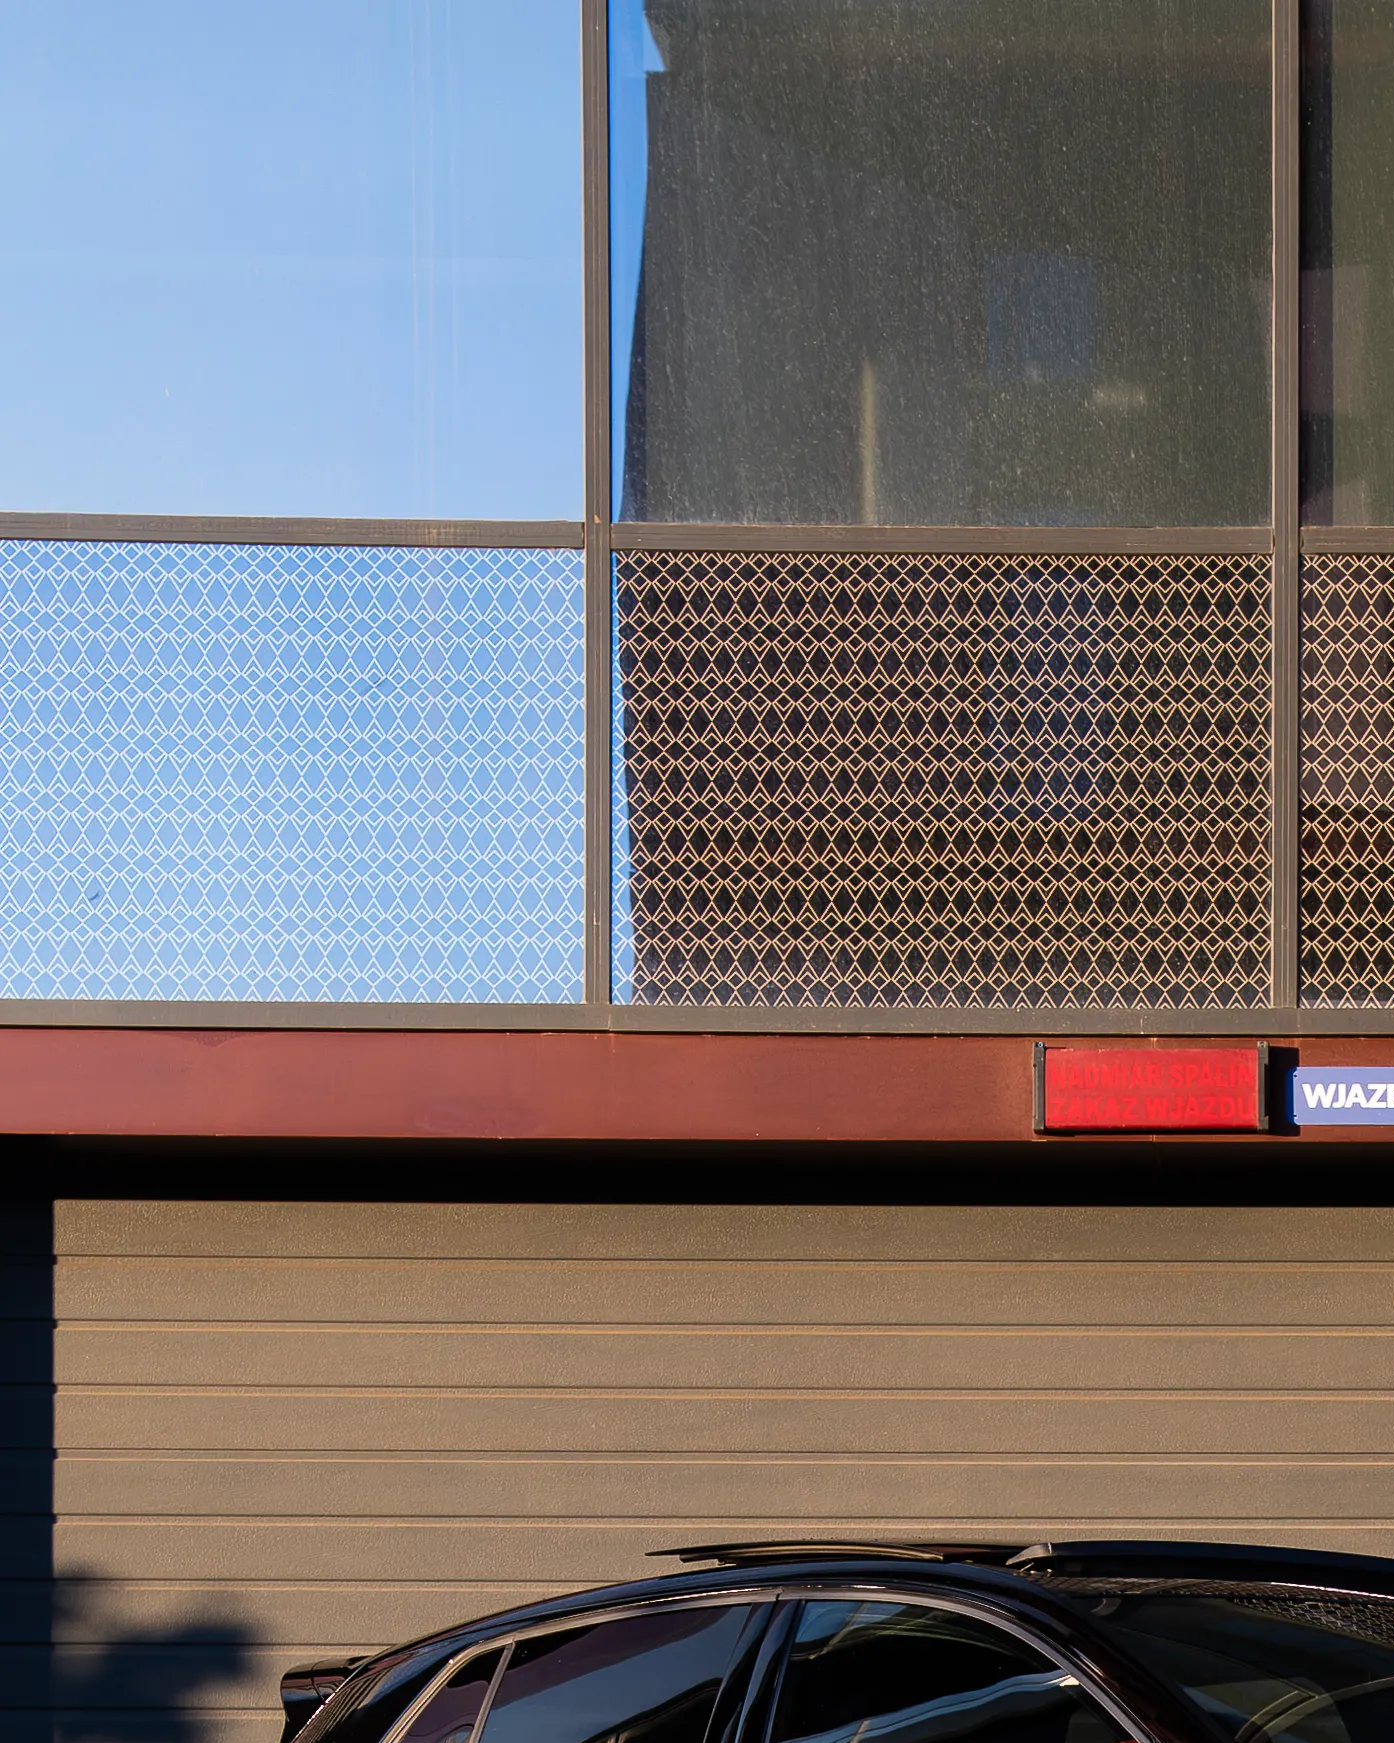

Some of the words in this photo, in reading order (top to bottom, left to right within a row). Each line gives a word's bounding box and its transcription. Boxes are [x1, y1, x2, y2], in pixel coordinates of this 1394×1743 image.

[1169, 1063, 1254, 1088] SPALIN
[1049, 1096, 1138, 1121] ZAKAZ
[1145, 1095, 1254, 1120] WJAZDU
